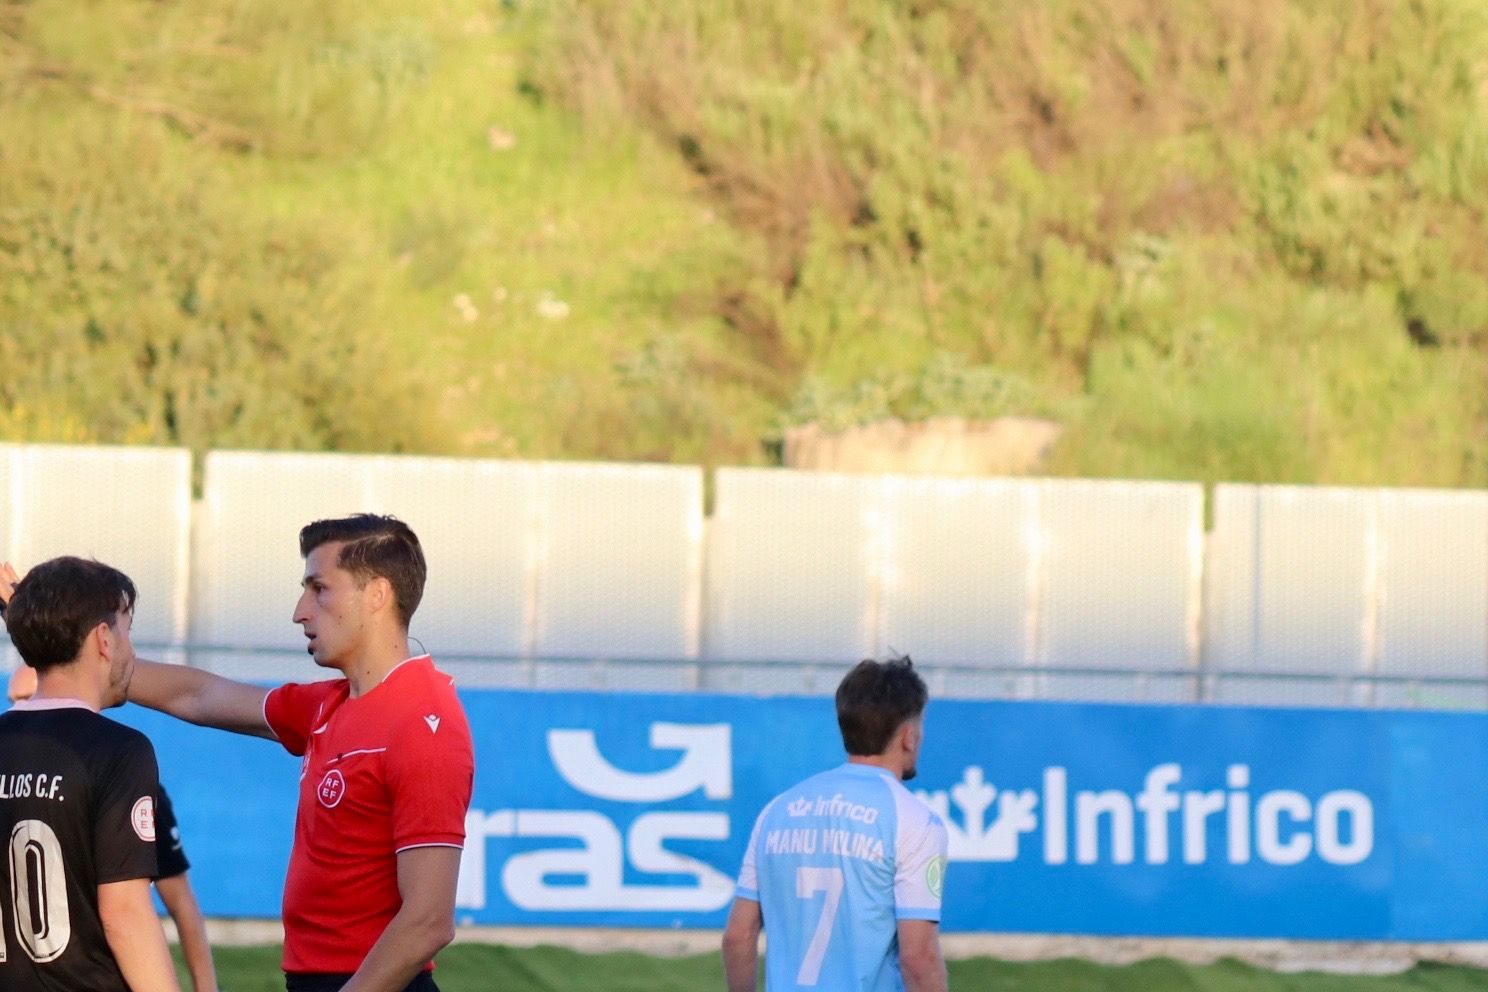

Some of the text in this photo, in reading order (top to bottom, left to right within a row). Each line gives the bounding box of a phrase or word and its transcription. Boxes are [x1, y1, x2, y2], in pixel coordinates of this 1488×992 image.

[35, 773, 65, 802] C.F.
[814, 793, 879, 825] Infrico
[1043, 763, 1375, 865] Infrico
[765, 829, 818, 854] MANU
[796, 867, 844, 986] 7
